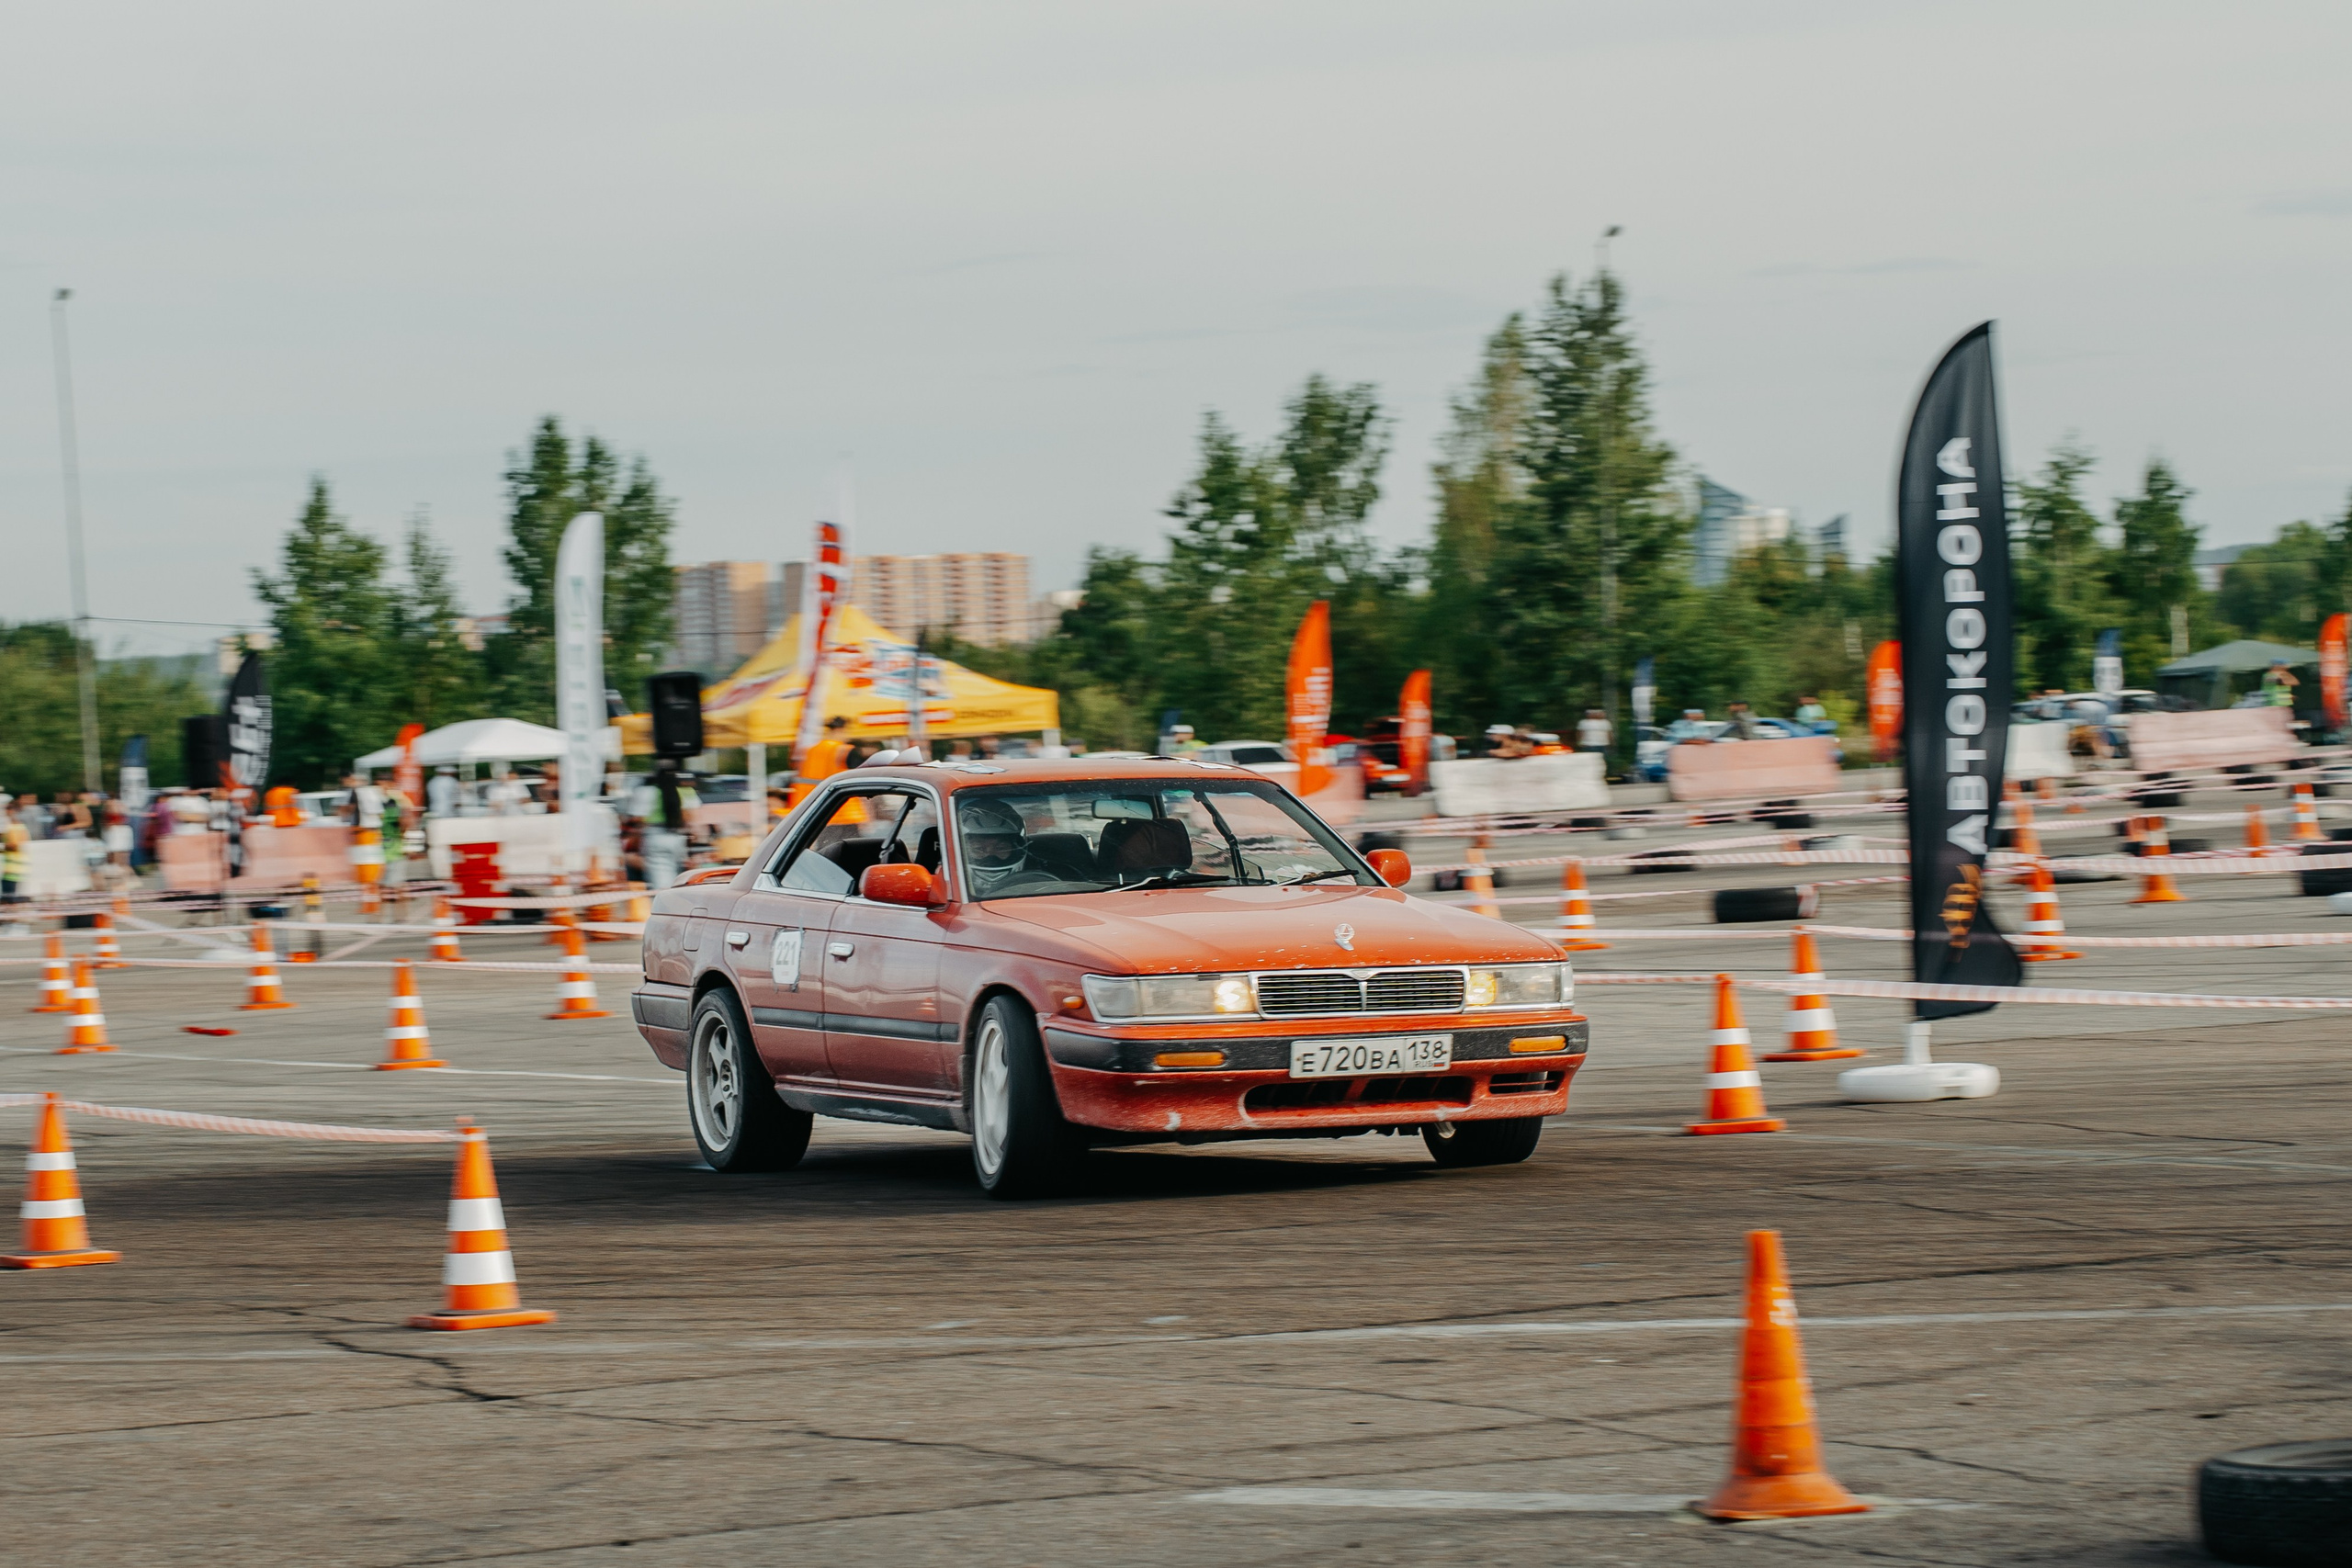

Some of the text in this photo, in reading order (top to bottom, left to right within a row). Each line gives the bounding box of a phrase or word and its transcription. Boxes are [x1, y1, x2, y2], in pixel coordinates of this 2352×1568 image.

[1936, 436, 1989, 855] АВТОКОРОНА
[776, 941, 797, 965] 221
[1408, 1040, 1442, 1060] 138
